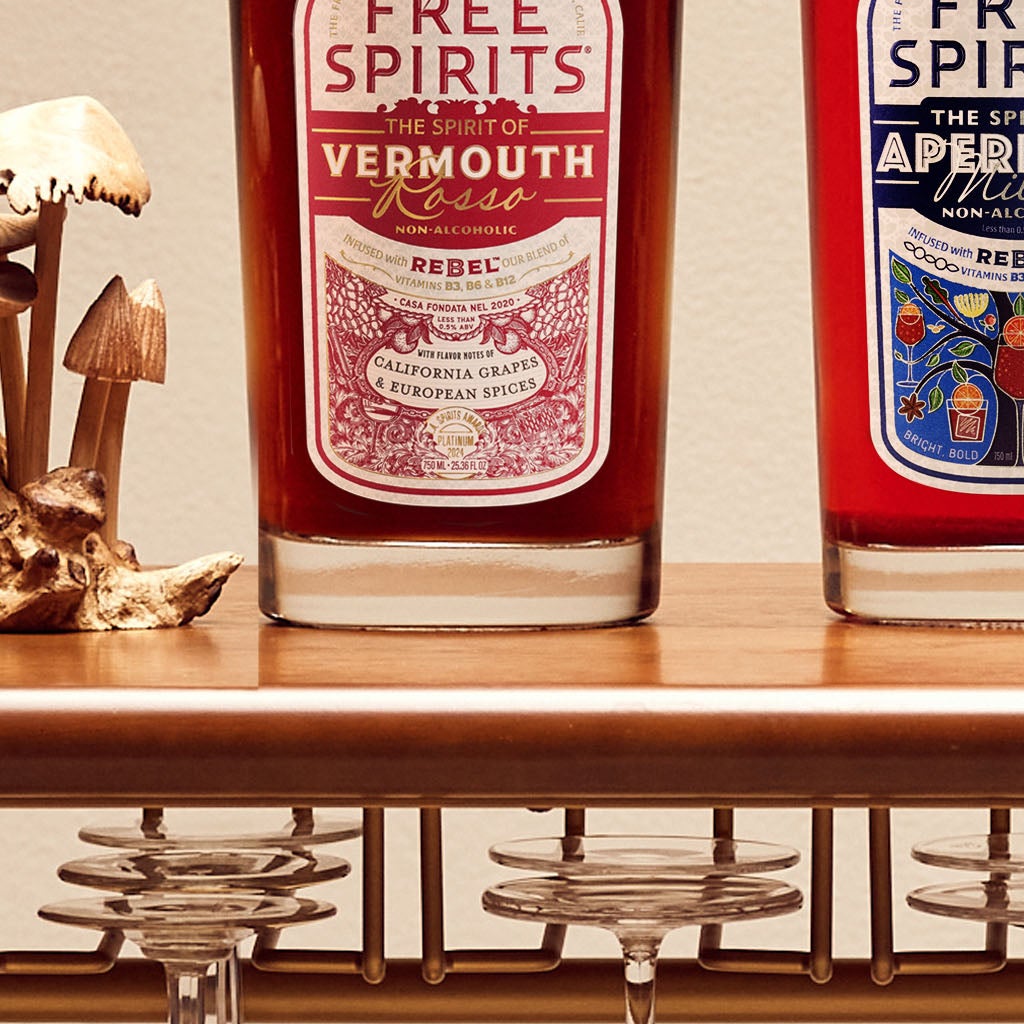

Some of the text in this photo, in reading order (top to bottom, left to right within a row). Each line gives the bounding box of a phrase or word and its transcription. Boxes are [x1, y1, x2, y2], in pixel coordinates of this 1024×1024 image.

[329, 15, 338, 38] THE
[893, 9, 902, 31] THE
[931, 109, 978, 126] THE
[385, 118, 529, 136] THE SPIRIT OF
[320, 143, 595, 181] VERMOUTH
[370, 154, 537, 221] Rosso
[395, 224, 518, 236] NON-ALCOHOLIC
[982, 224, 997, 232] Less
[998, 224, 1015, 234] than
[343, 234, 383, 259] INFUSED
[385, 254, 408, 268] with
[502, 252, 525, 267] OUR
[527, 242, 558, 262] BLEND
[559, 234, 571, 248] of
[908, 227, 949, 252] INFUSED
[950, 246, 973, 259] with
[961, 266, 1007, 281] VITAMINS
[394, 275, 517, 293] VITAMINS B3, B6 & B12
[400, 298, 515, 313] CASA FONDATA NEL 2020
[417, 349, 494, 360] WITH FLAVOR NOTES OF
[374, 356, 539, 380] CALIFORNIA GRAPES
[375, 377, 537, 400] & EUROPEAN SPICES
[437, 435, 474, 447] PLATINUM
[949, 448, 979, 460] BOLD
[423, 461, 435, 470] 750
[436, 461, 446, 470] ML
[470, 461, 477, 470] FL
[478, 461, 487, 470] OZ
